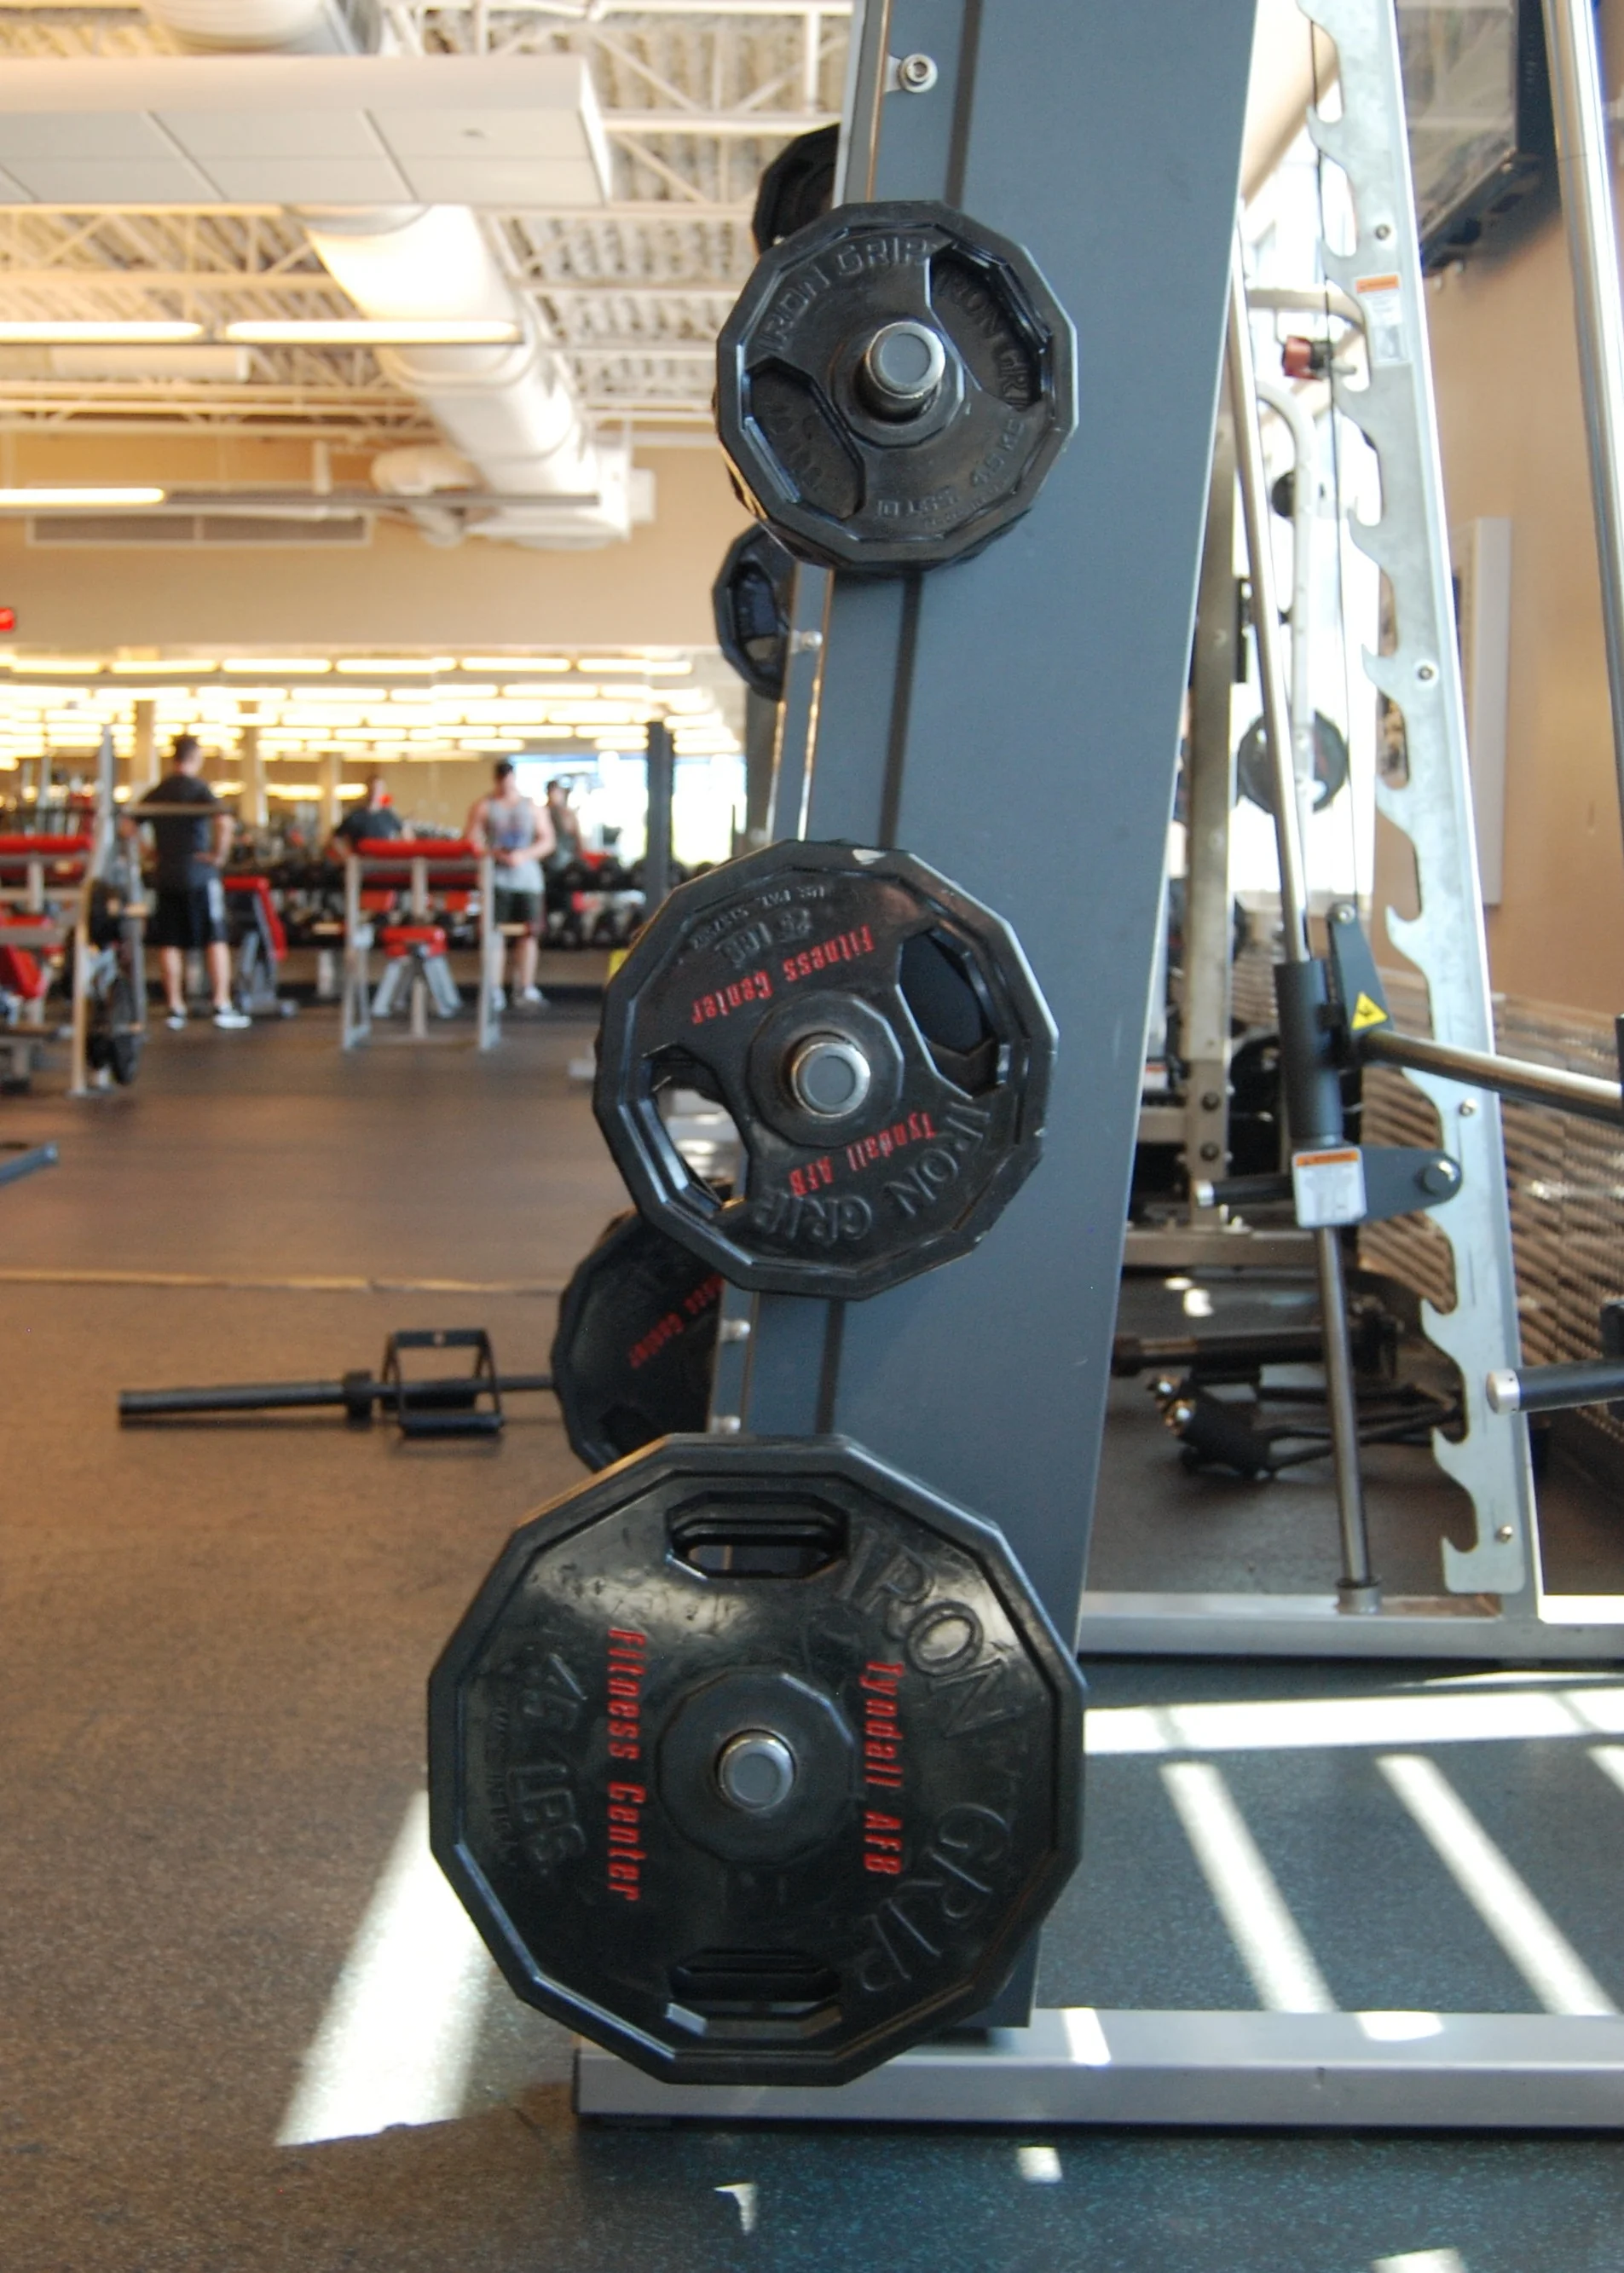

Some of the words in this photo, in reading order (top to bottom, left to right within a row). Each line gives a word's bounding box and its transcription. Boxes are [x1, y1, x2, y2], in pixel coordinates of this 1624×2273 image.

[757, 262, 830, 352] IRON
[835, 236, 929, 277] GRIP
[998, 348, 1031, 411] GRI
[691, 970, 774, 1025] Center
[783, 924, 875, 983] Fitness
[789, 1156, 834, 1197] AFB
[846, 1112, 938, 1171] Tyndall
[883, 1099, 991, 1220] IRON
[752, 1188, 874, 1247] GRIP
[835, 1521, 1021, 1739] IRON
[608, 1628, 647, 1761] Fitness
[859, 1660, 905, 1789] Tyndall
[608, 1780, 647, 1902] Center
[863, 1809, 904, 1877] AFB
[859, 1801, 1014, 1992] GRIP
